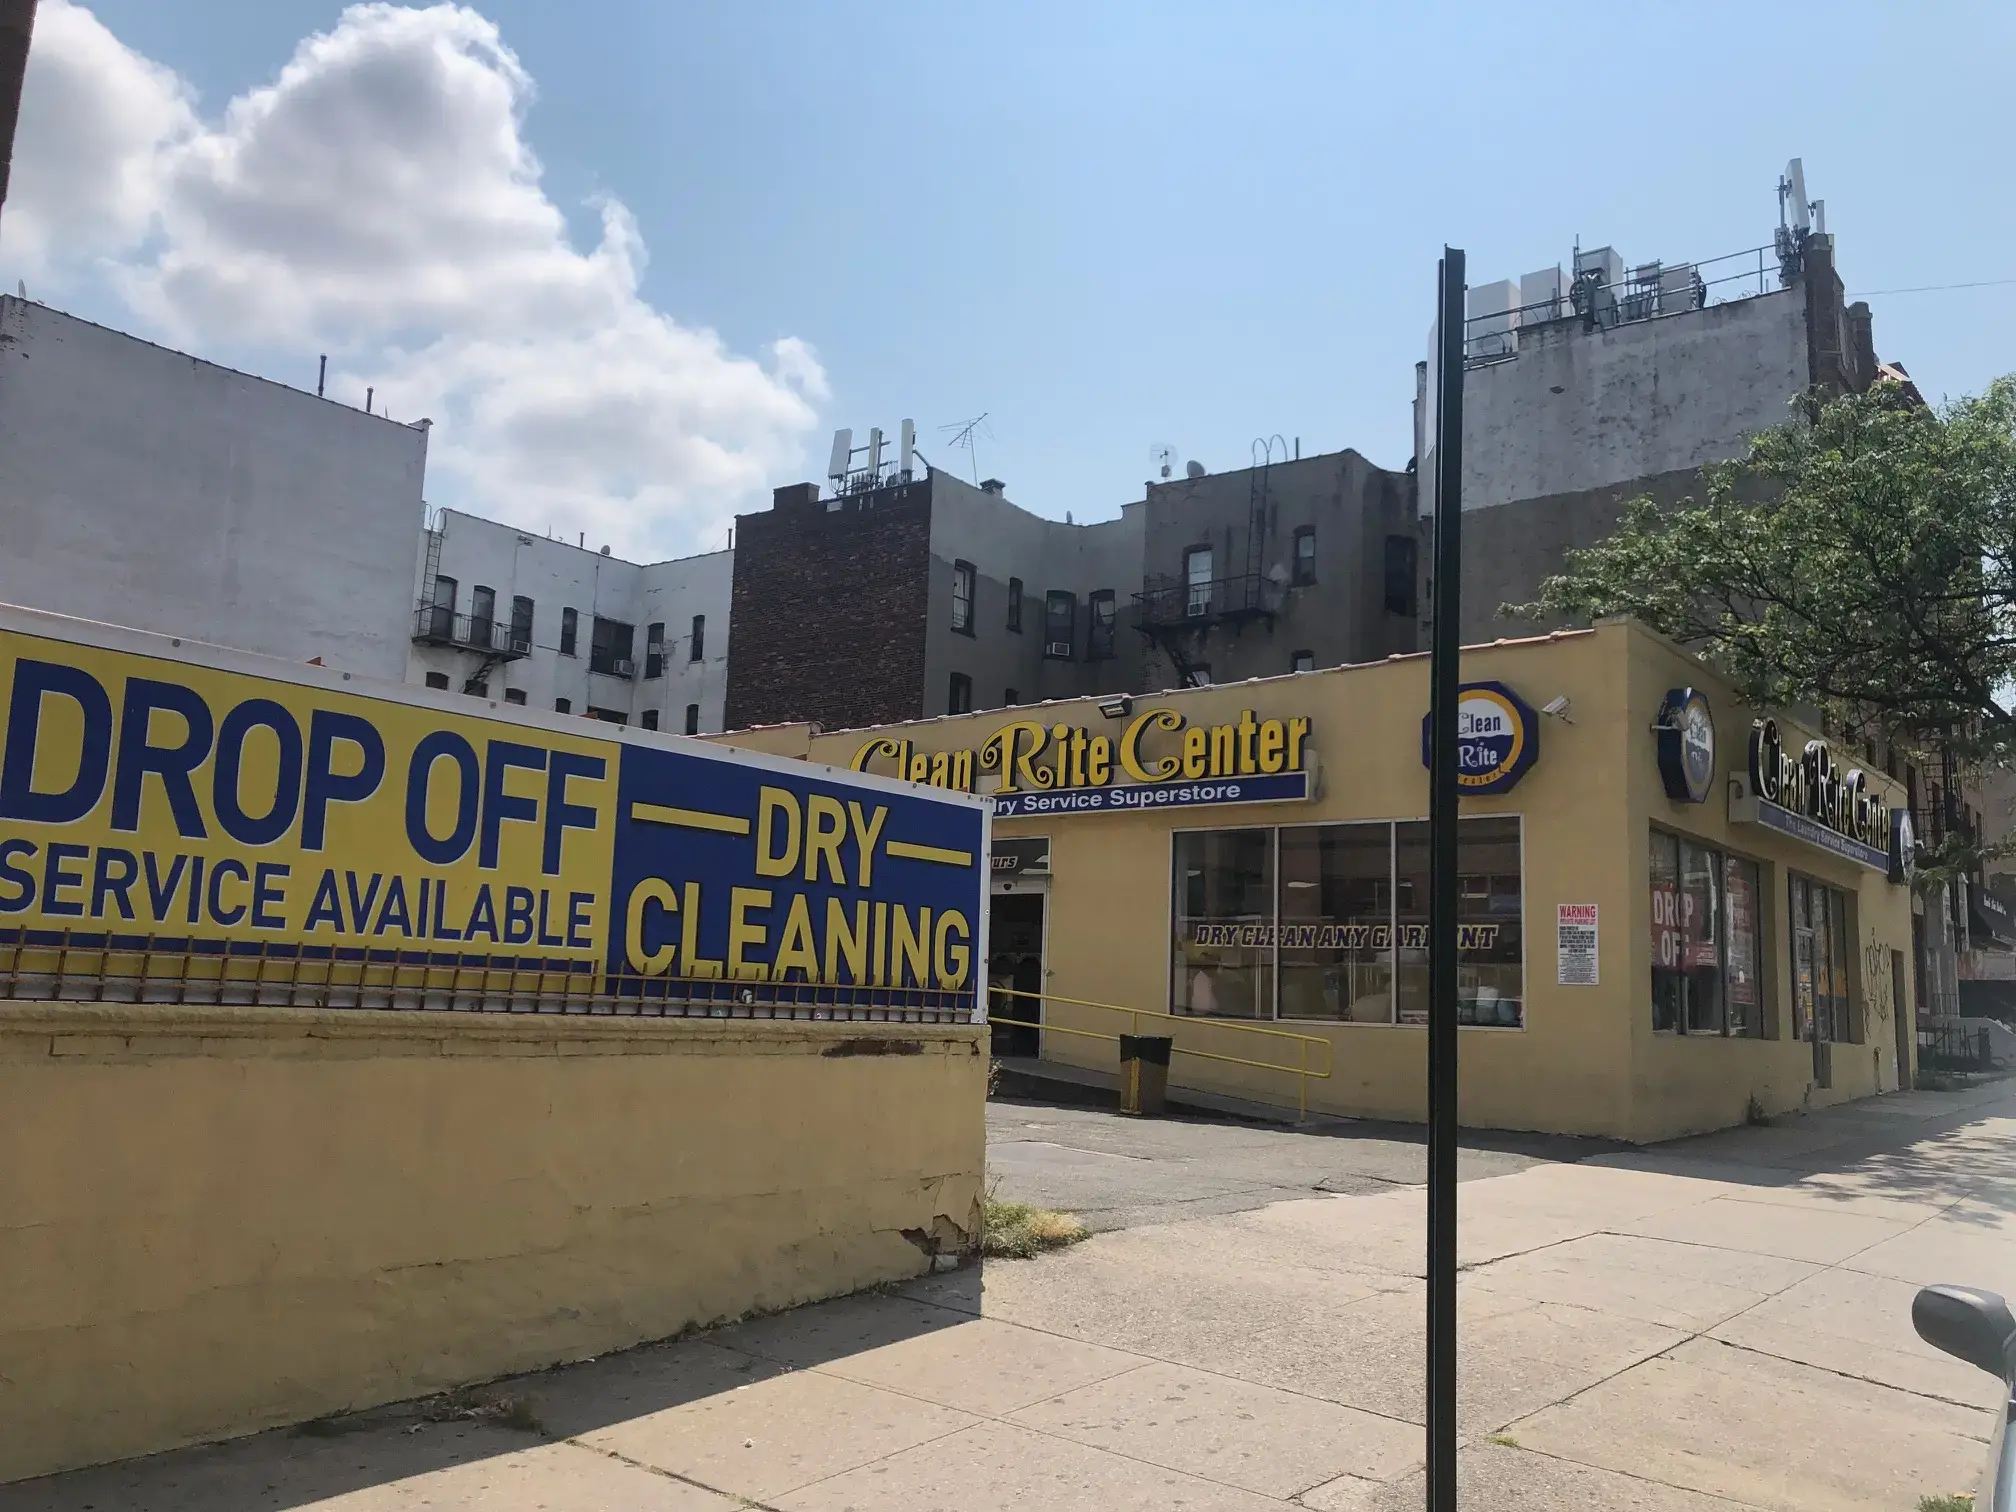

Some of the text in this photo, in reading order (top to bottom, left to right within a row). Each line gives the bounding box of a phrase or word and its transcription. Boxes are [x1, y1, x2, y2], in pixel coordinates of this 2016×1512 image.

[0, 658, 607, 876] DROP OFF
[979, 719, 1112, 794] Rite
[1120, 708, 1309, 782] Center
[1458, 741, 1498, 767] Rite
[755, 784, 888, 888] DRY
[1023, 790, 1103, 814] Service
[1109, 783, 1241, 809] Superstore
[0, 838, 595, 949] SERVICE AVAILABLE
[625, 876, 970, 990] CLEANING
[1560, 905, 1596, 918] WARNING
[1194, 925, 1239, 947] DRY
[1241, 925, 1316, 948] CLEAN
[1318, 925, 1370, 949] ANY
